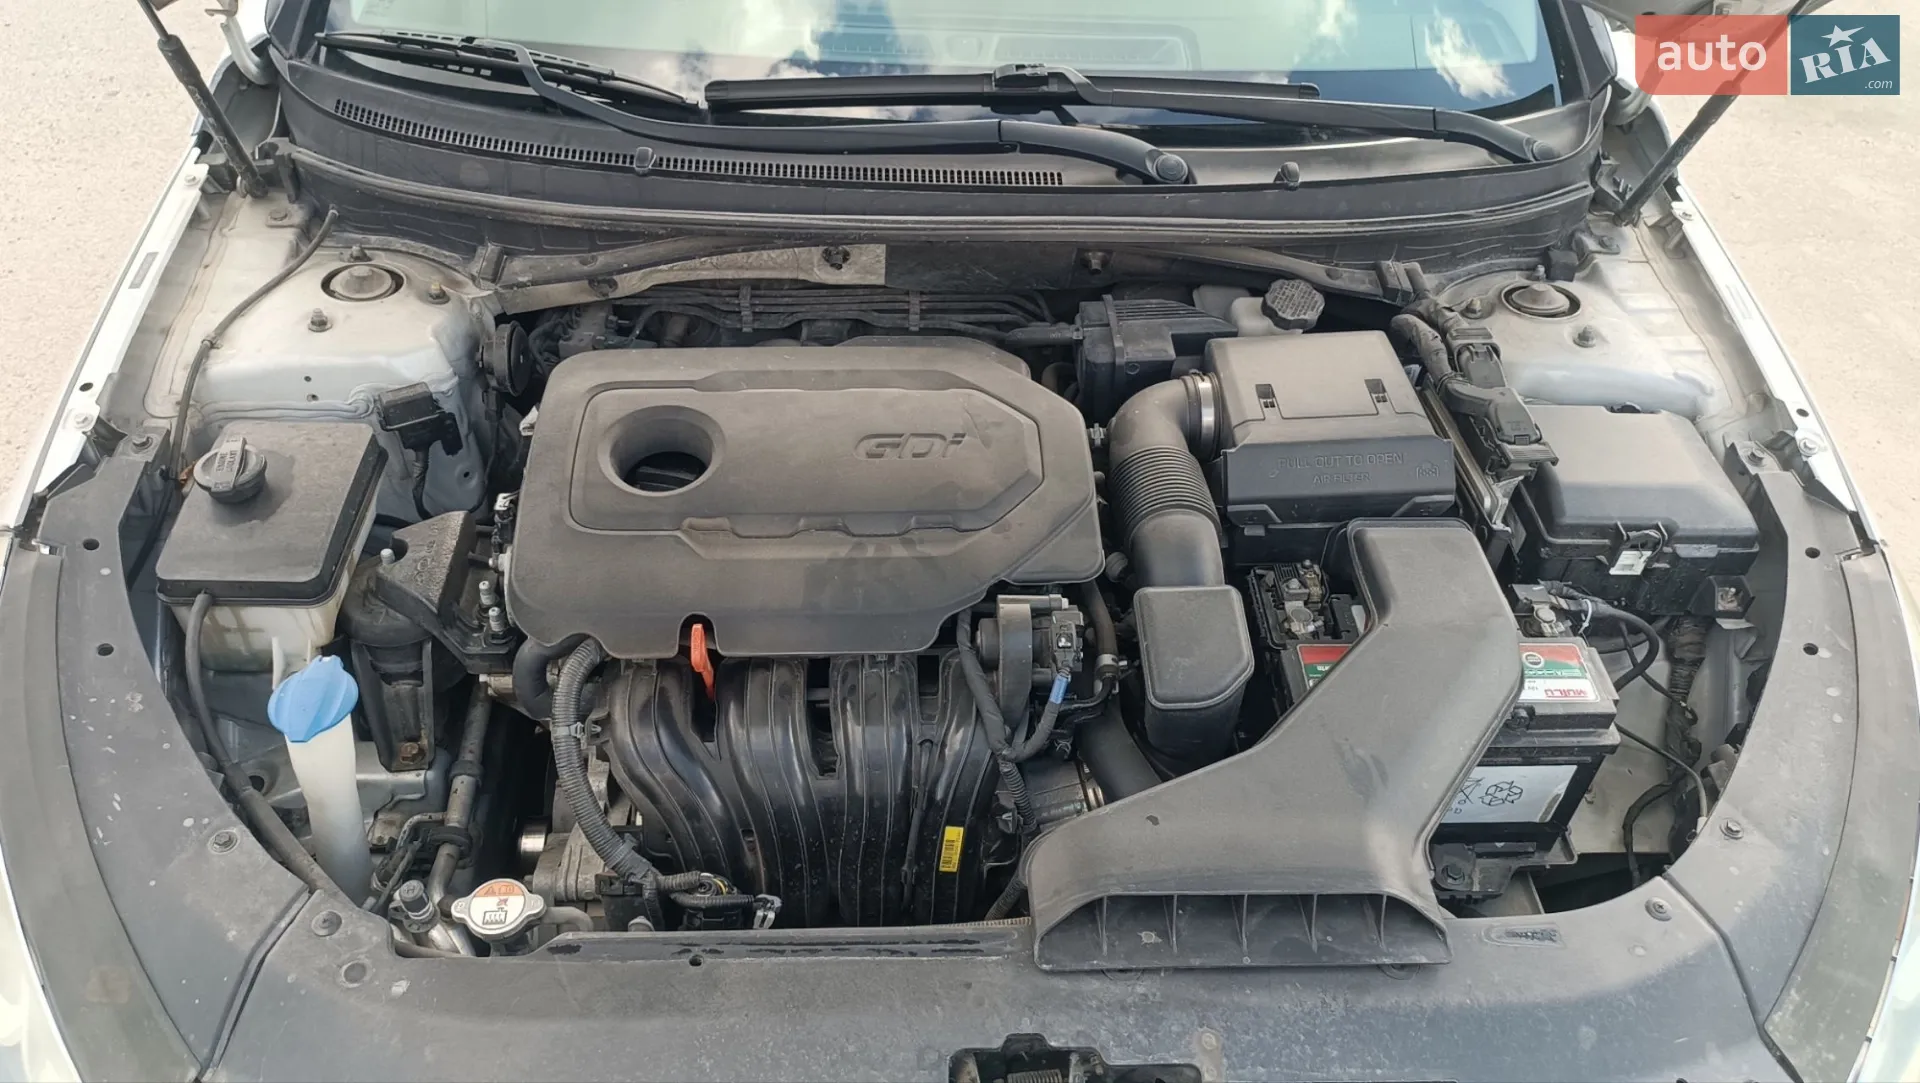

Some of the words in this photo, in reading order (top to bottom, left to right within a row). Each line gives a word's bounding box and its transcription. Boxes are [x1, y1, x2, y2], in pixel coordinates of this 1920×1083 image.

[1278, 456, 1311, 469] PULL
[1315, 455, 1342, 468] OUT
[1346, 455, 1364, 467] TO
[1367, 453, 1404, 466] OPEN
[1313, 473, 1331, 484] AIR
[1334, 472, 1371, 483] FILTER
